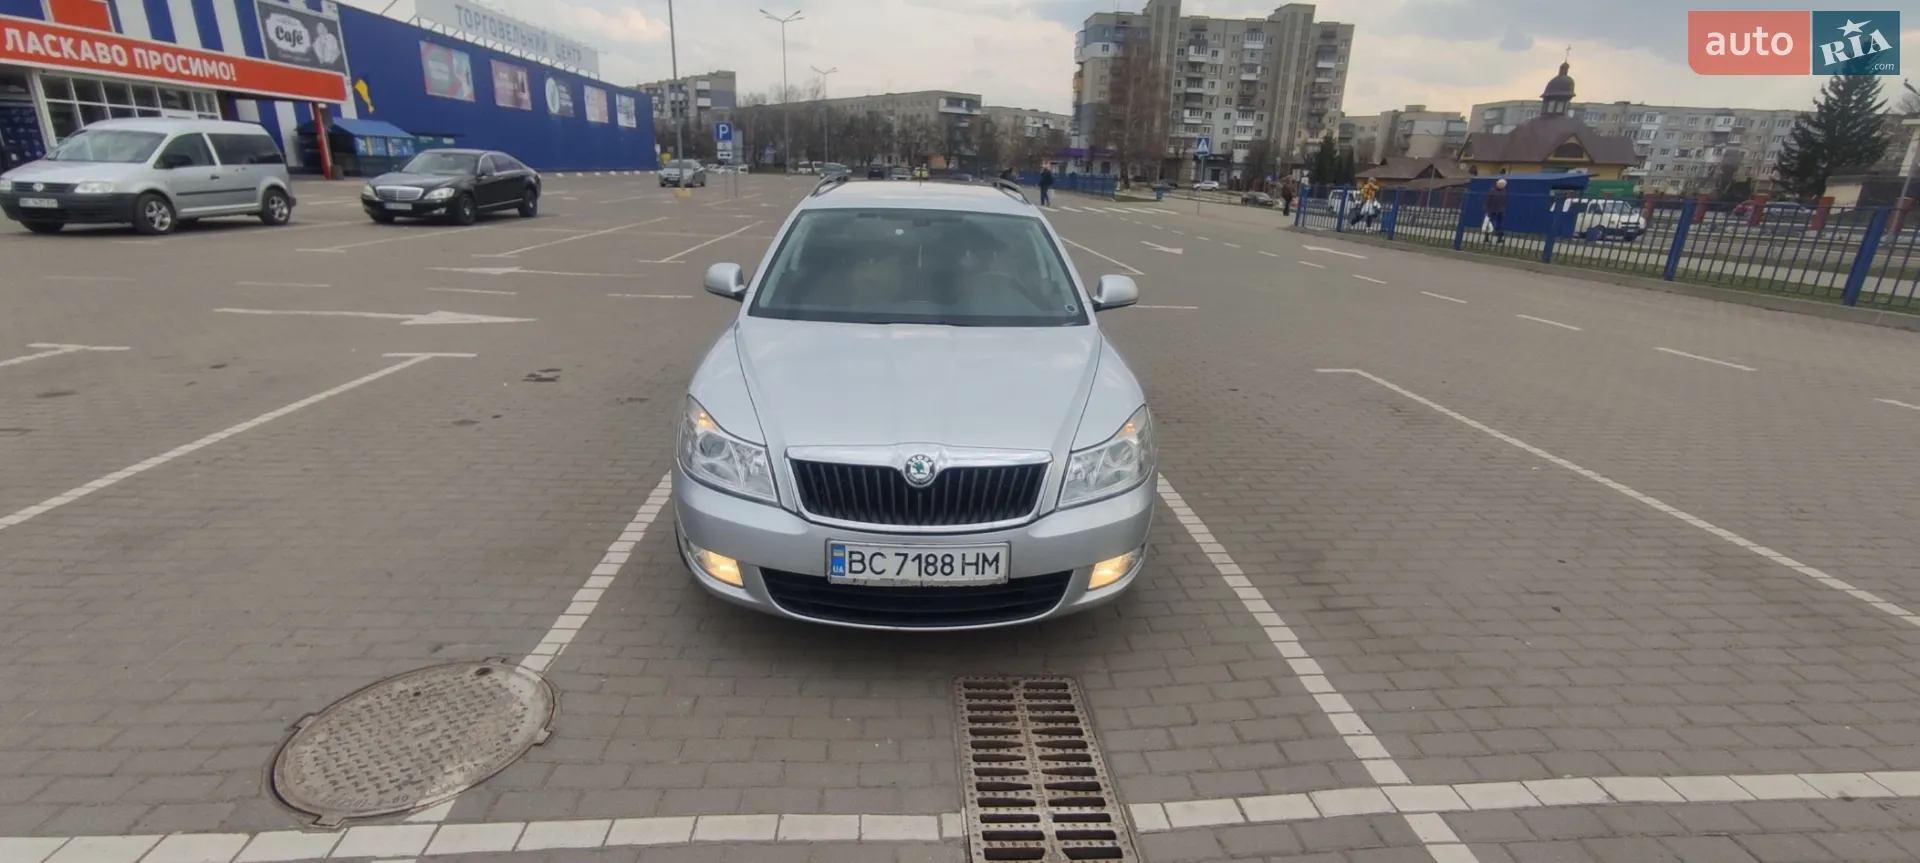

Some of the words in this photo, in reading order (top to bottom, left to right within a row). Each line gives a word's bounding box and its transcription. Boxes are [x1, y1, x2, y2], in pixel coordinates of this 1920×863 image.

[455, 5, 550, 53] ТОРГОВЕЛЬНИЙ
[554, 42, 583, 63] ЦЕНТР
[4, 27, 129, 68] ЛАСКАВО
[132, 47, 238, 82] ПРОСИМО!
[719, 123, 729, 139] P
[832, 565, 845, 574] UA
[848, 550, 887, 575] BC
[894, 552, 955, 577] 7188
[961, 551, 1000, 576] HM
